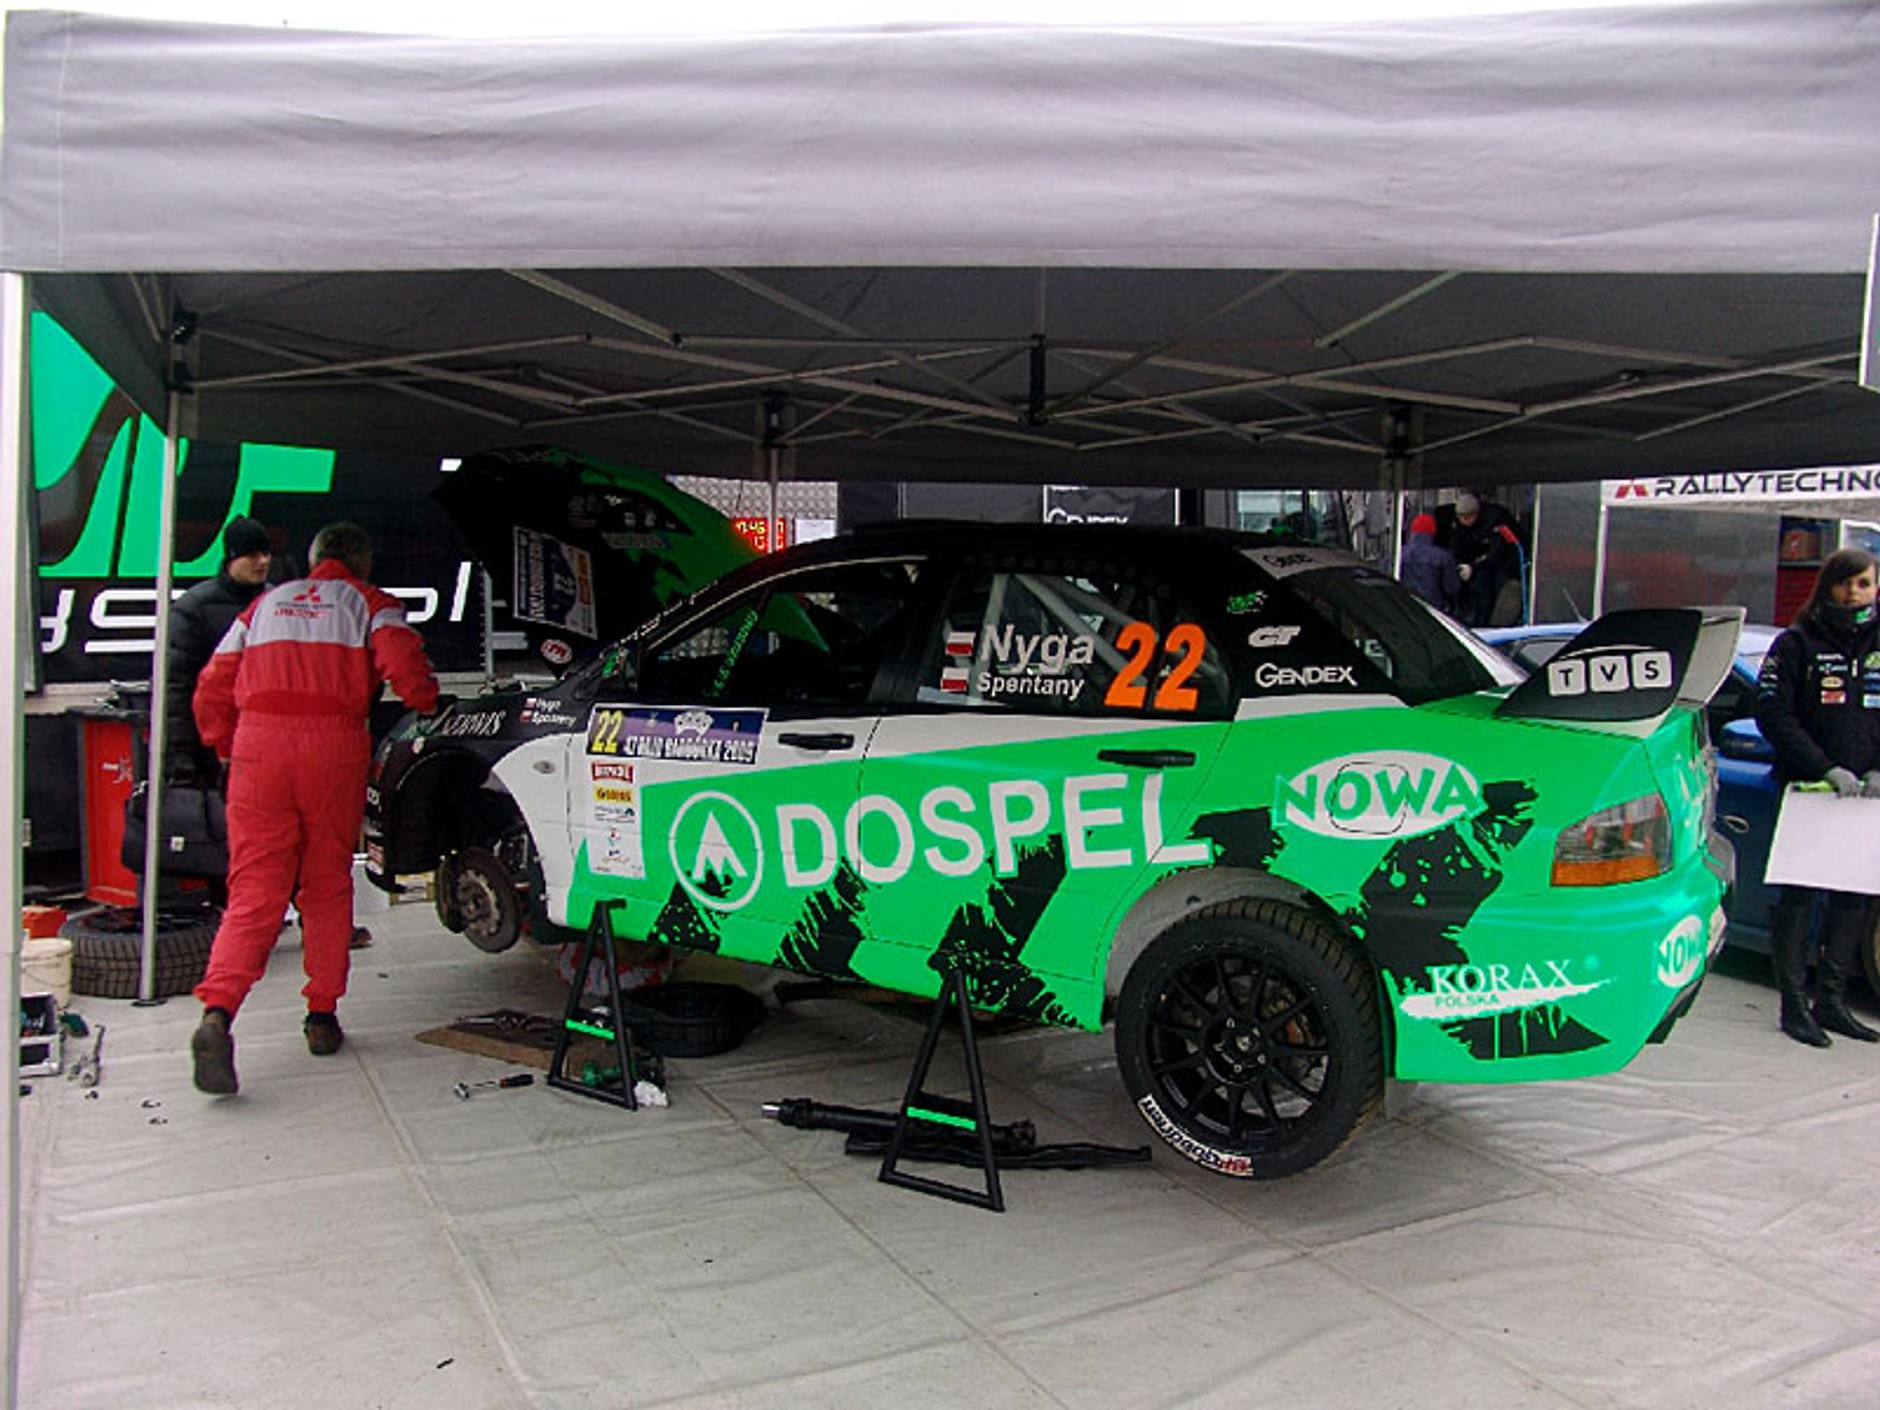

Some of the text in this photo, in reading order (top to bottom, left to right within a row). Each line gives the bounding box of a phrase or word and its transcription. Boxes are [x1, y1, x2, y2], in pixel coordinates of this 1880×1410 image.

[981, 623, 1095, 676] Nyga
[1104, 621, 1206, 711] 22
[976, 671, 1085, 700] Spentany
[1558, 660, 1660, 688] TVS
[591, 710, 623, 753] 22
[1272, 762, 1486, 825] NOWA
[776, 773, 1209, 887] DOSPEL
[1425, 958, 1571, 994] KORAX
[1434, 994, 1499, 1008] POLSKA
